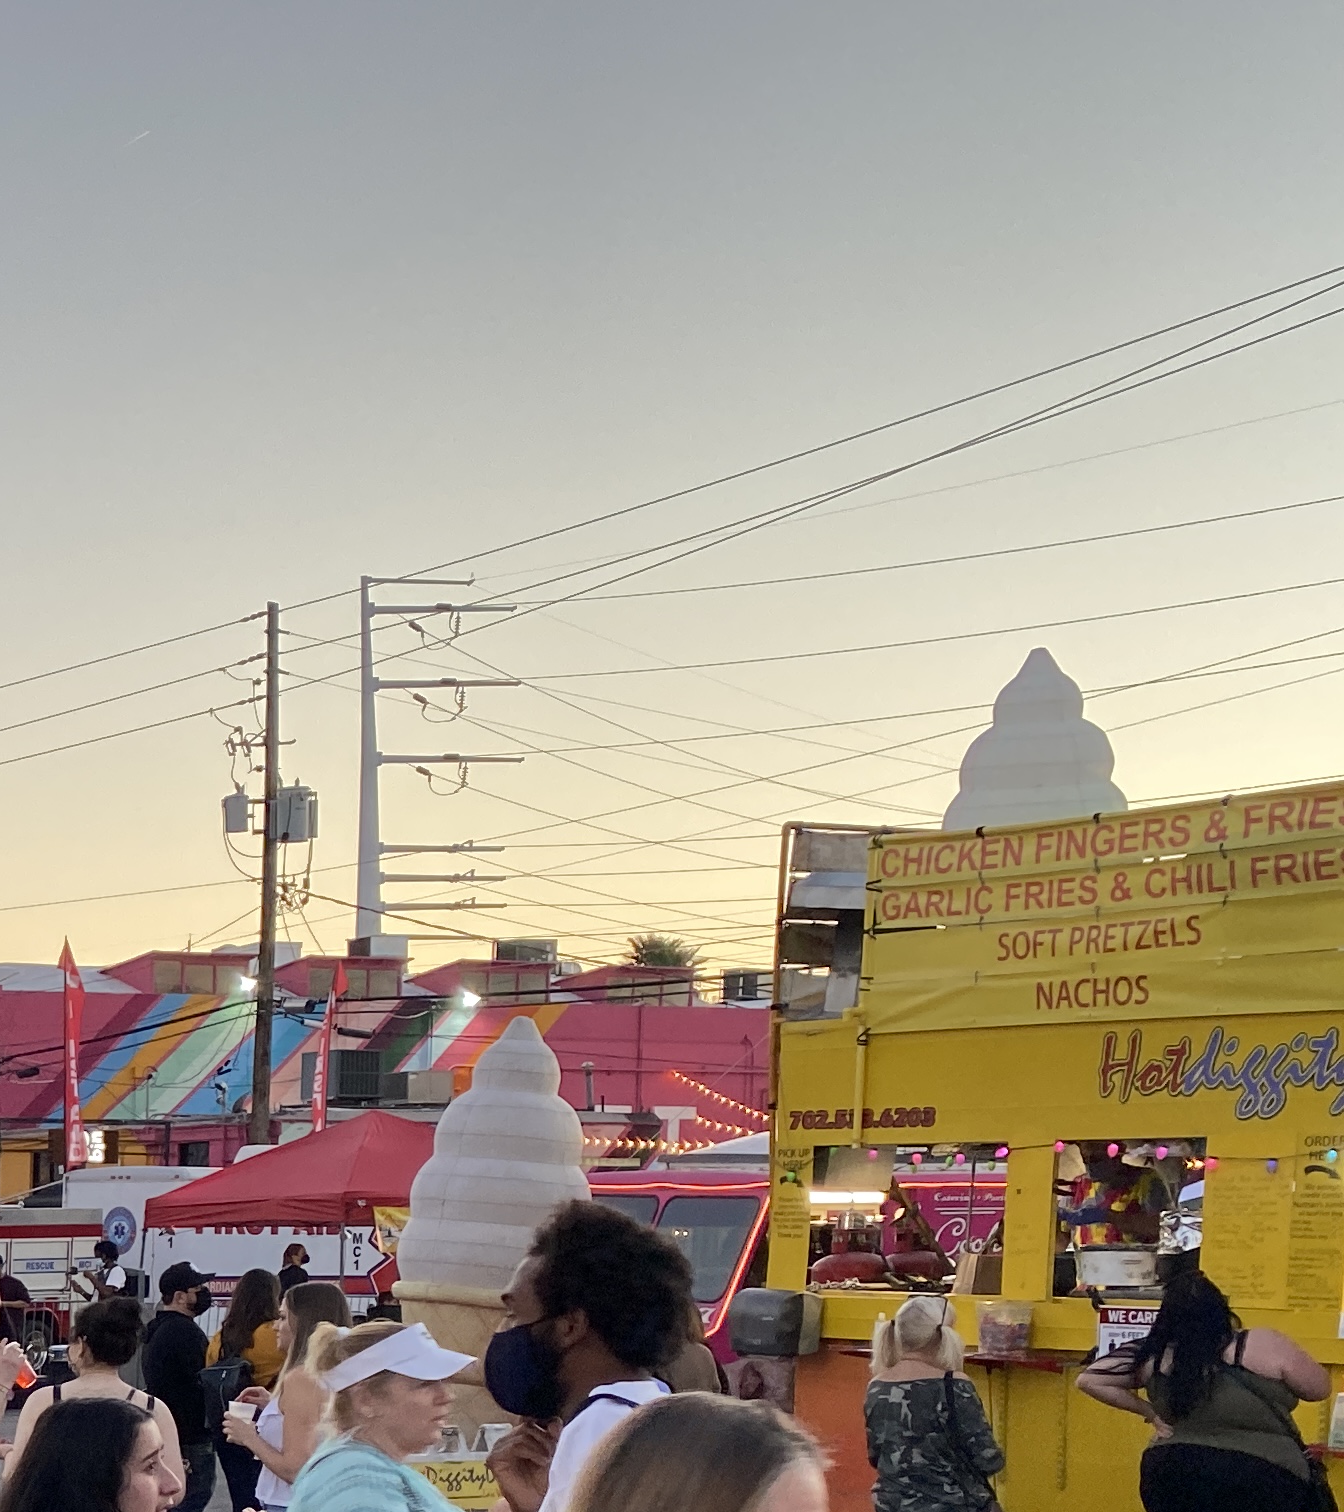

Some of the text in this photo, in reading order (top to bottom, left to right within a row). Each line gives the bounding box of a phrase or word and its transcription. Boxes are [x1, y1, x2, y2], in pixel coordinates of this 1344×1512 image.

[881, 834, 1024, 878] CHICKEN
[1034, 814, 1191, 864] FINGERS
[1203, 809, 1229, 843] &
[881, 848, 1344, 921] GARLIC FRIES & CHILI FRIE
[996, 914, 1203, 962] SOFT PRETZELS
[1035, 975, 1149, 1010] NACHOS
[25, 1261, 55, 1270] RESCUE
[1107, 1309, 1127, 1323] WE
